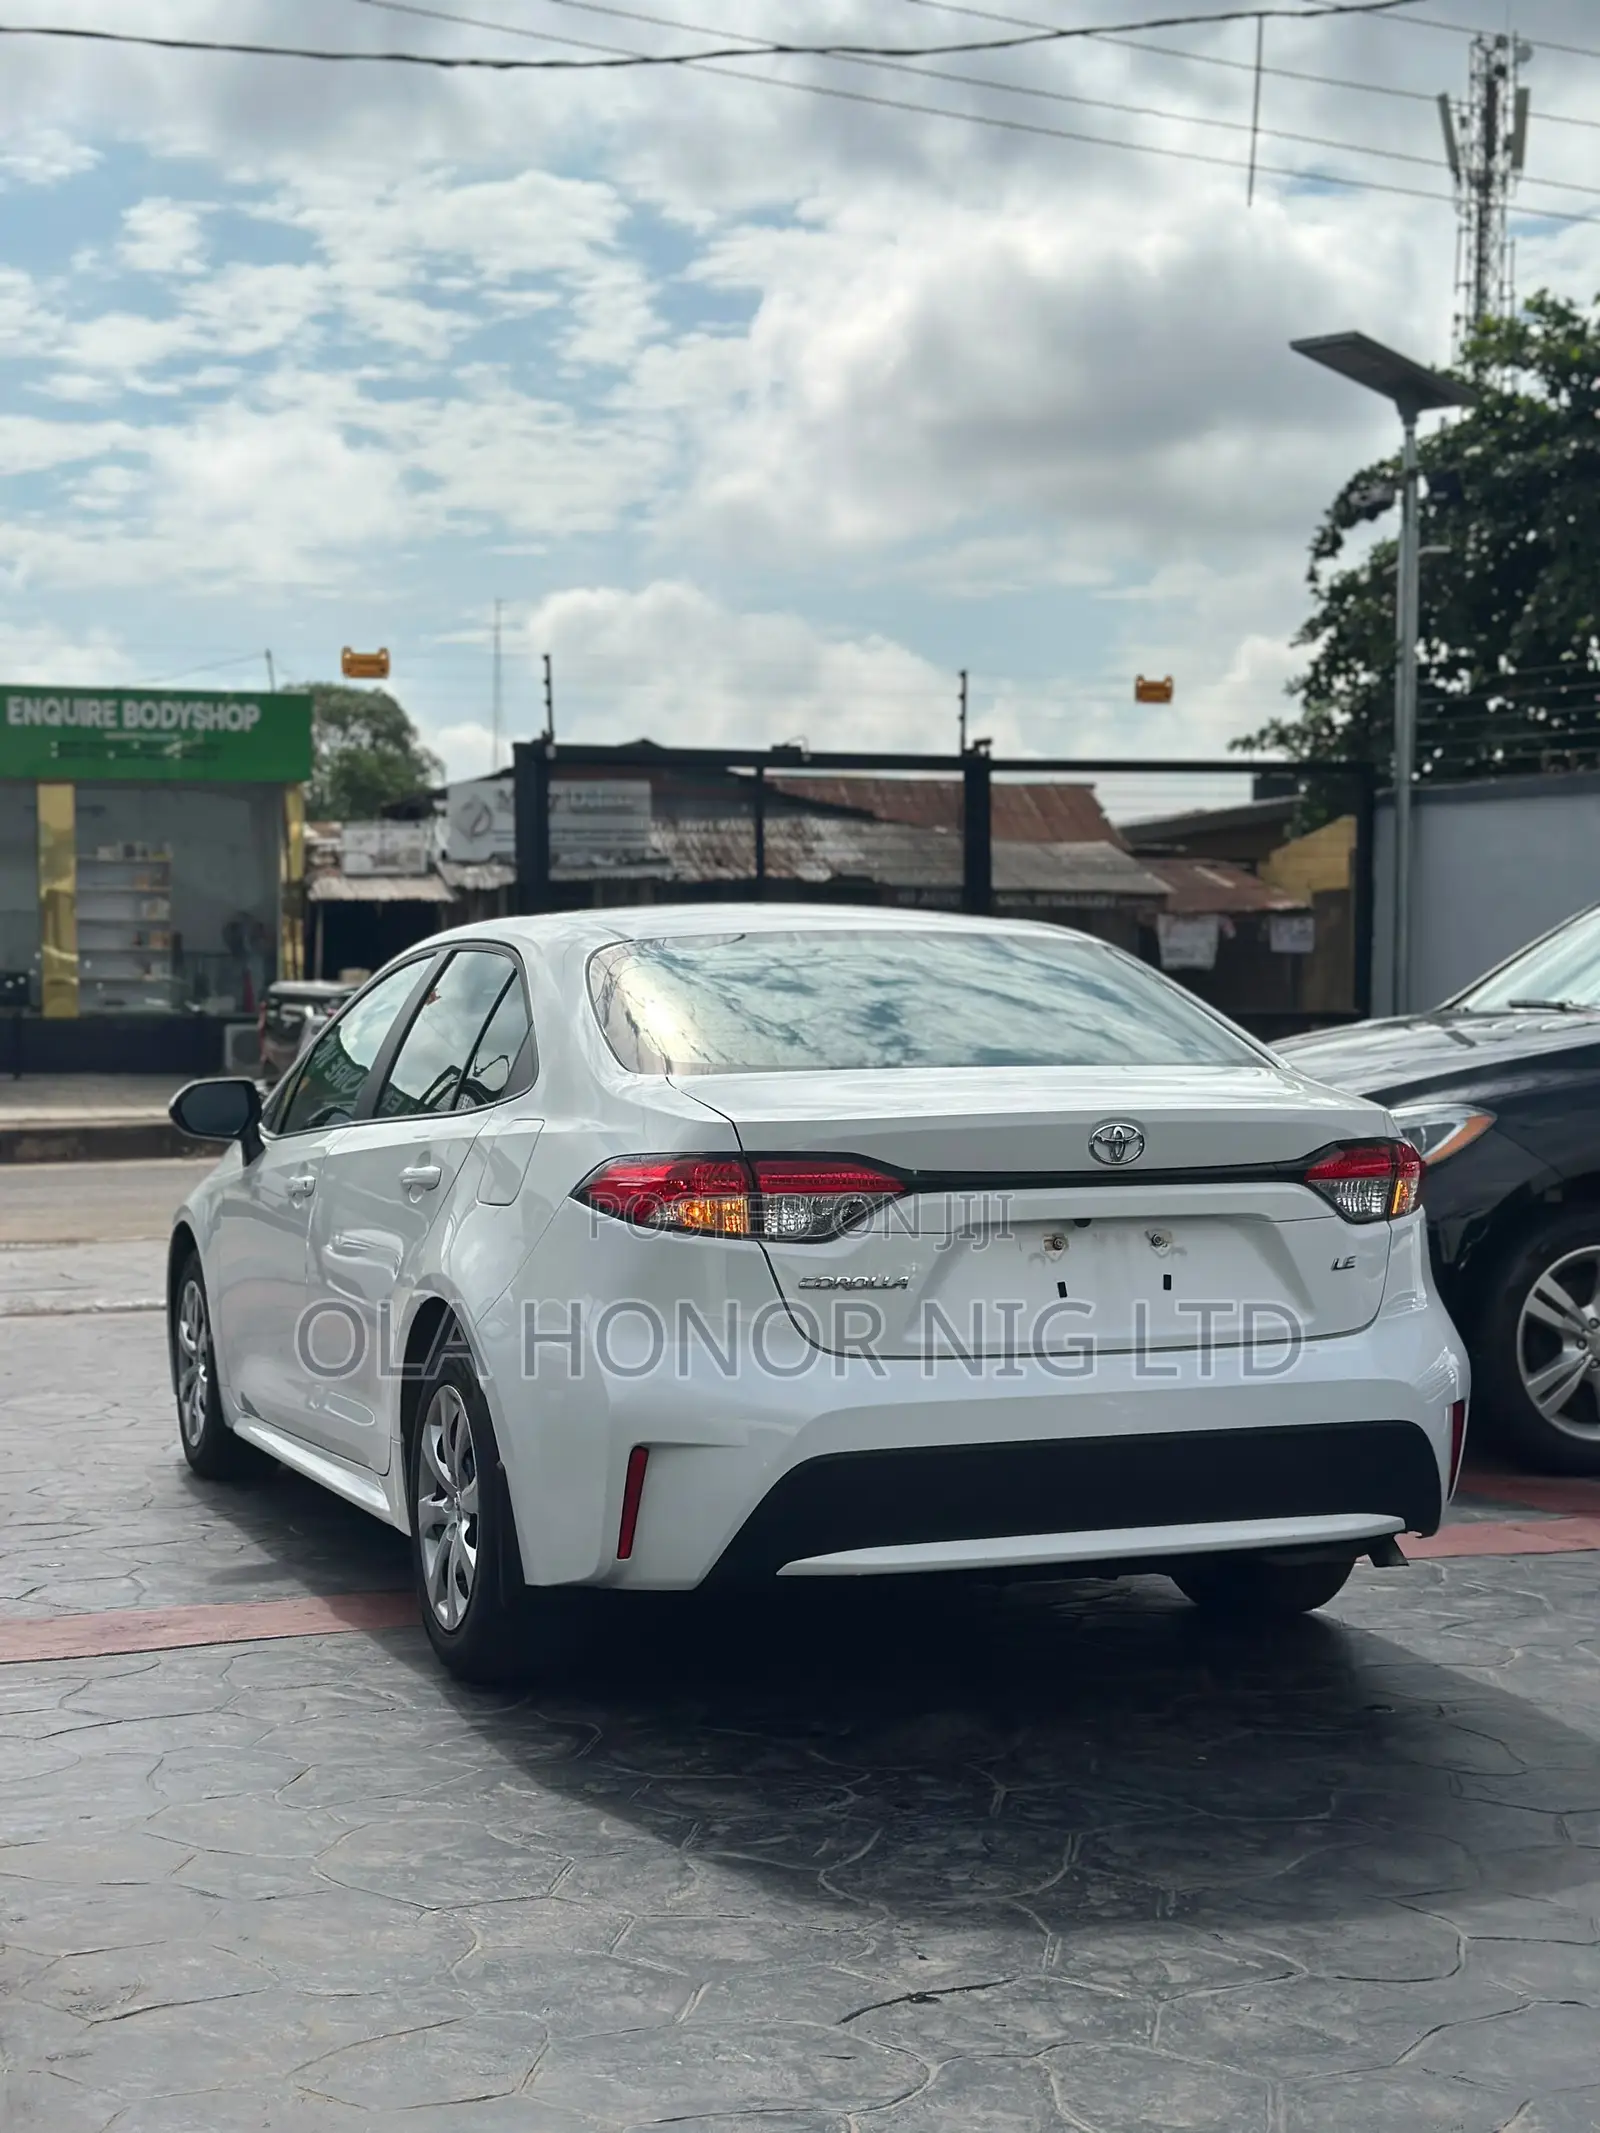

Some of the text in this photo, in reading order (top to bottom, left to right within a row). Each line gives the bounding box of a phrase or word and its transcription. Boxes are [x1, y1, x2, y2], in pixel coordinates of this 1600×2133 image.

[7, 696, 261, 731] ENQUIRE BODYSHOP
[1331, 1255, 1356, 1271] LE
[798, 1276, 909, 1291] COROLLA
